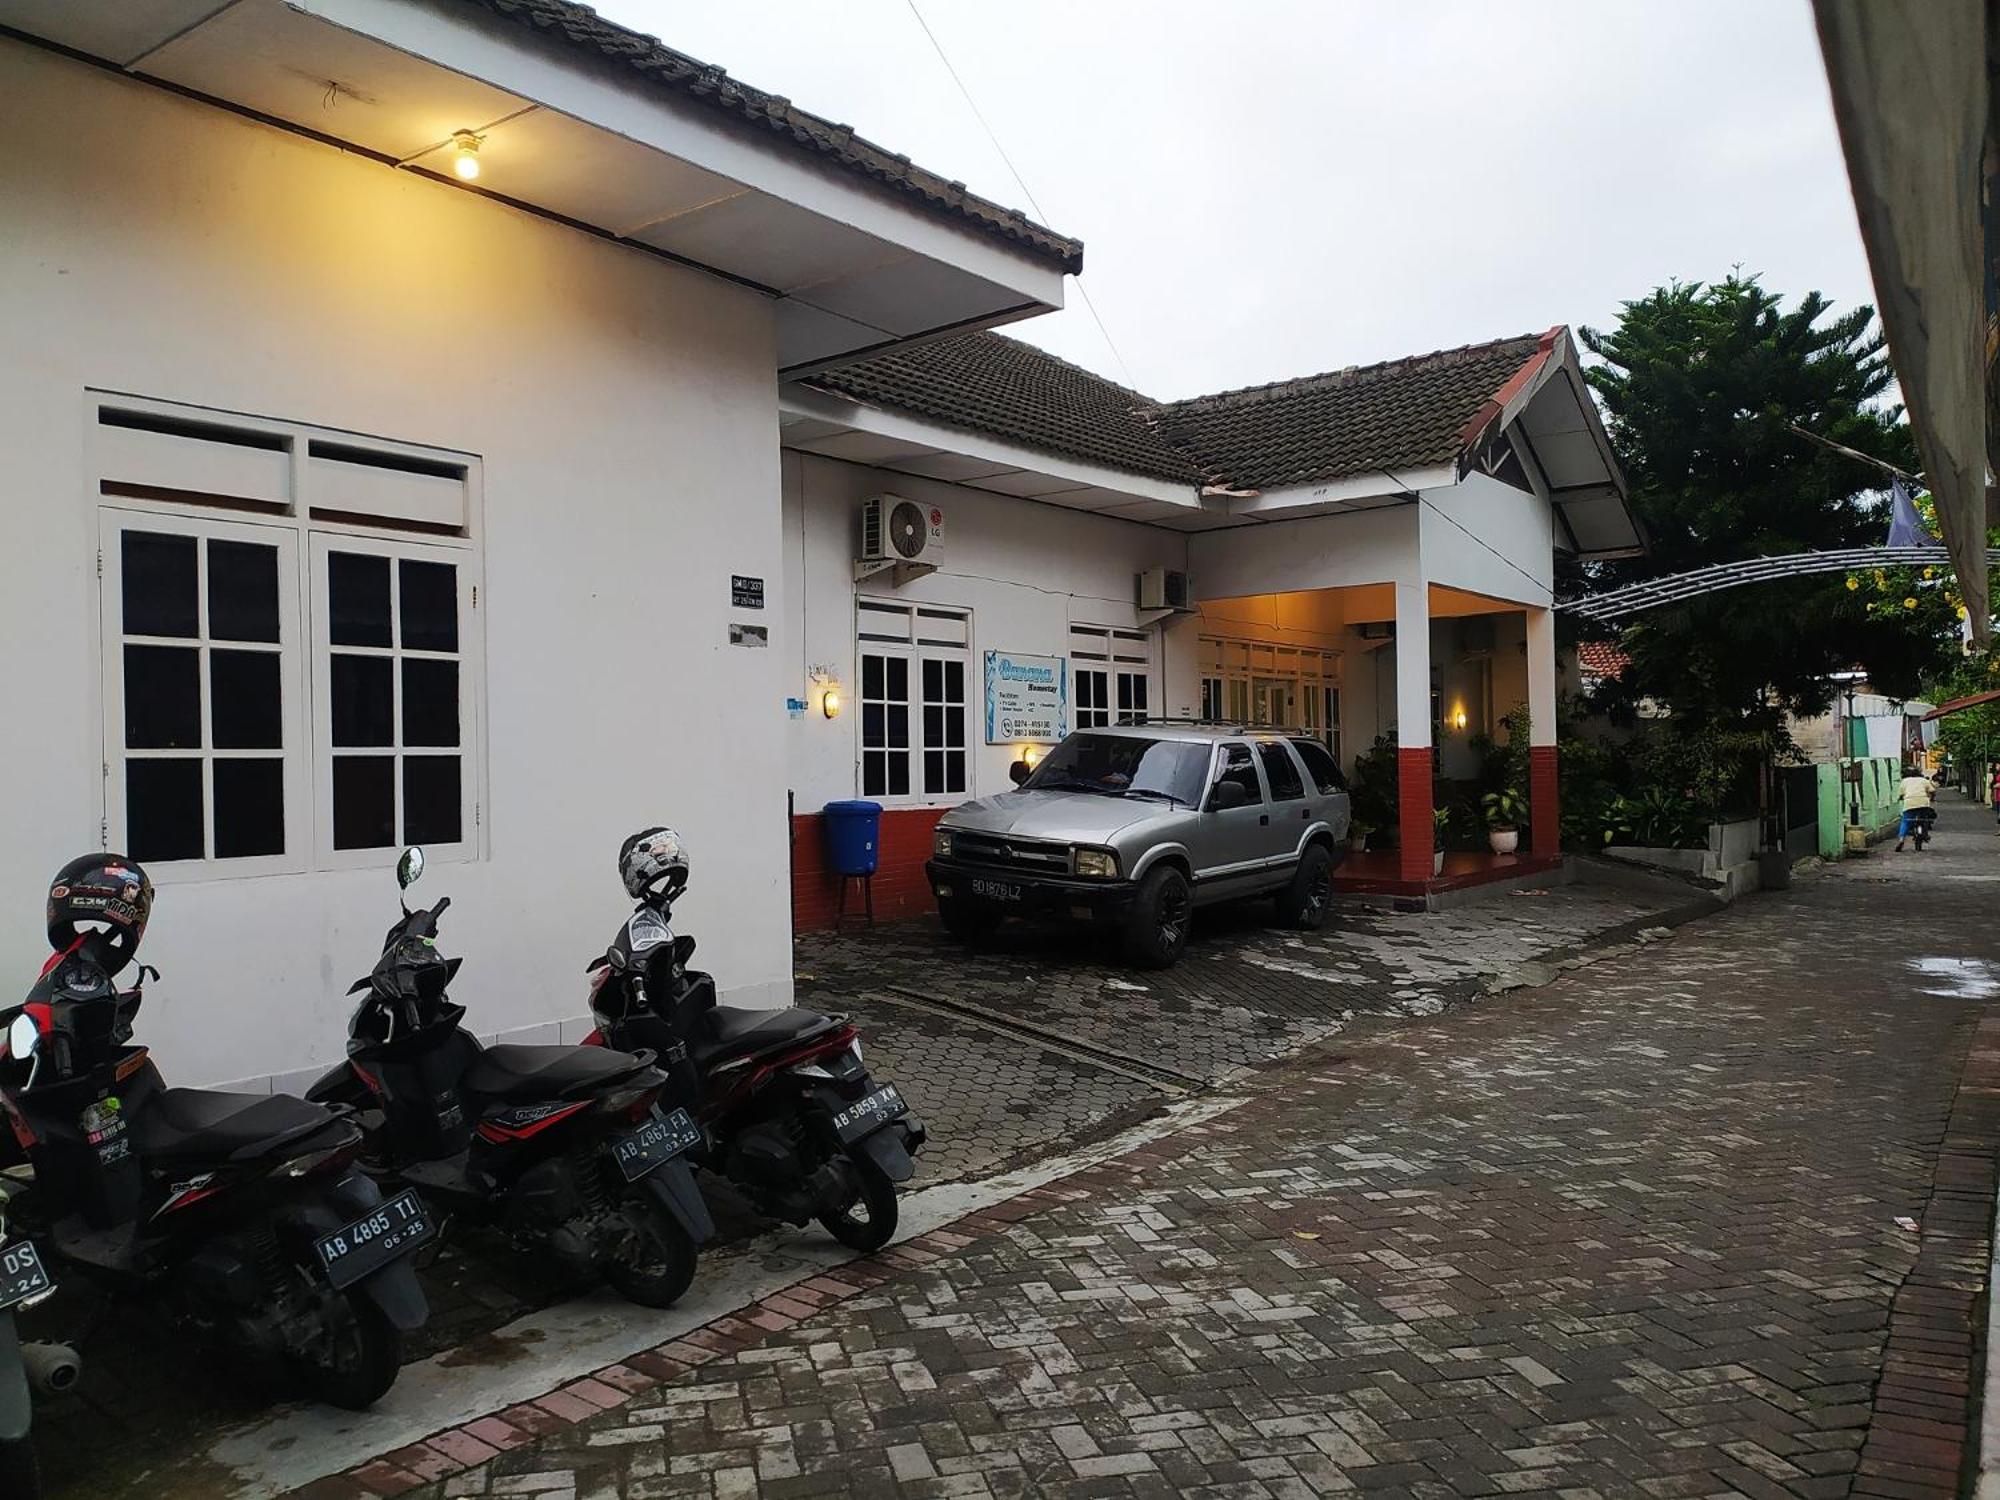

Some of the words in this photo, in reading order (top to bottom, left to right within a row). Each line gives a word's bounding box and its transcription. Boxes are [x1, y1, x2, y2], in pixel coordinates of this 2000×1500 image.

[931, 528, 941, 537] LG
[833, 1112, 850, 1130] AB
[849, 1096, 878, 1119] 5859
[620, 1141, 638, 1162] AB
[640, 1123, 670, 1147] 4862
[670, 1113, 689, 1130] FA
[325, 1236, 348, 1262] AB
[353, 1212, 390, 1245] 4885
[394, 1198, 416, 1220] TI
[3, 1247, 35, 1274] DS
